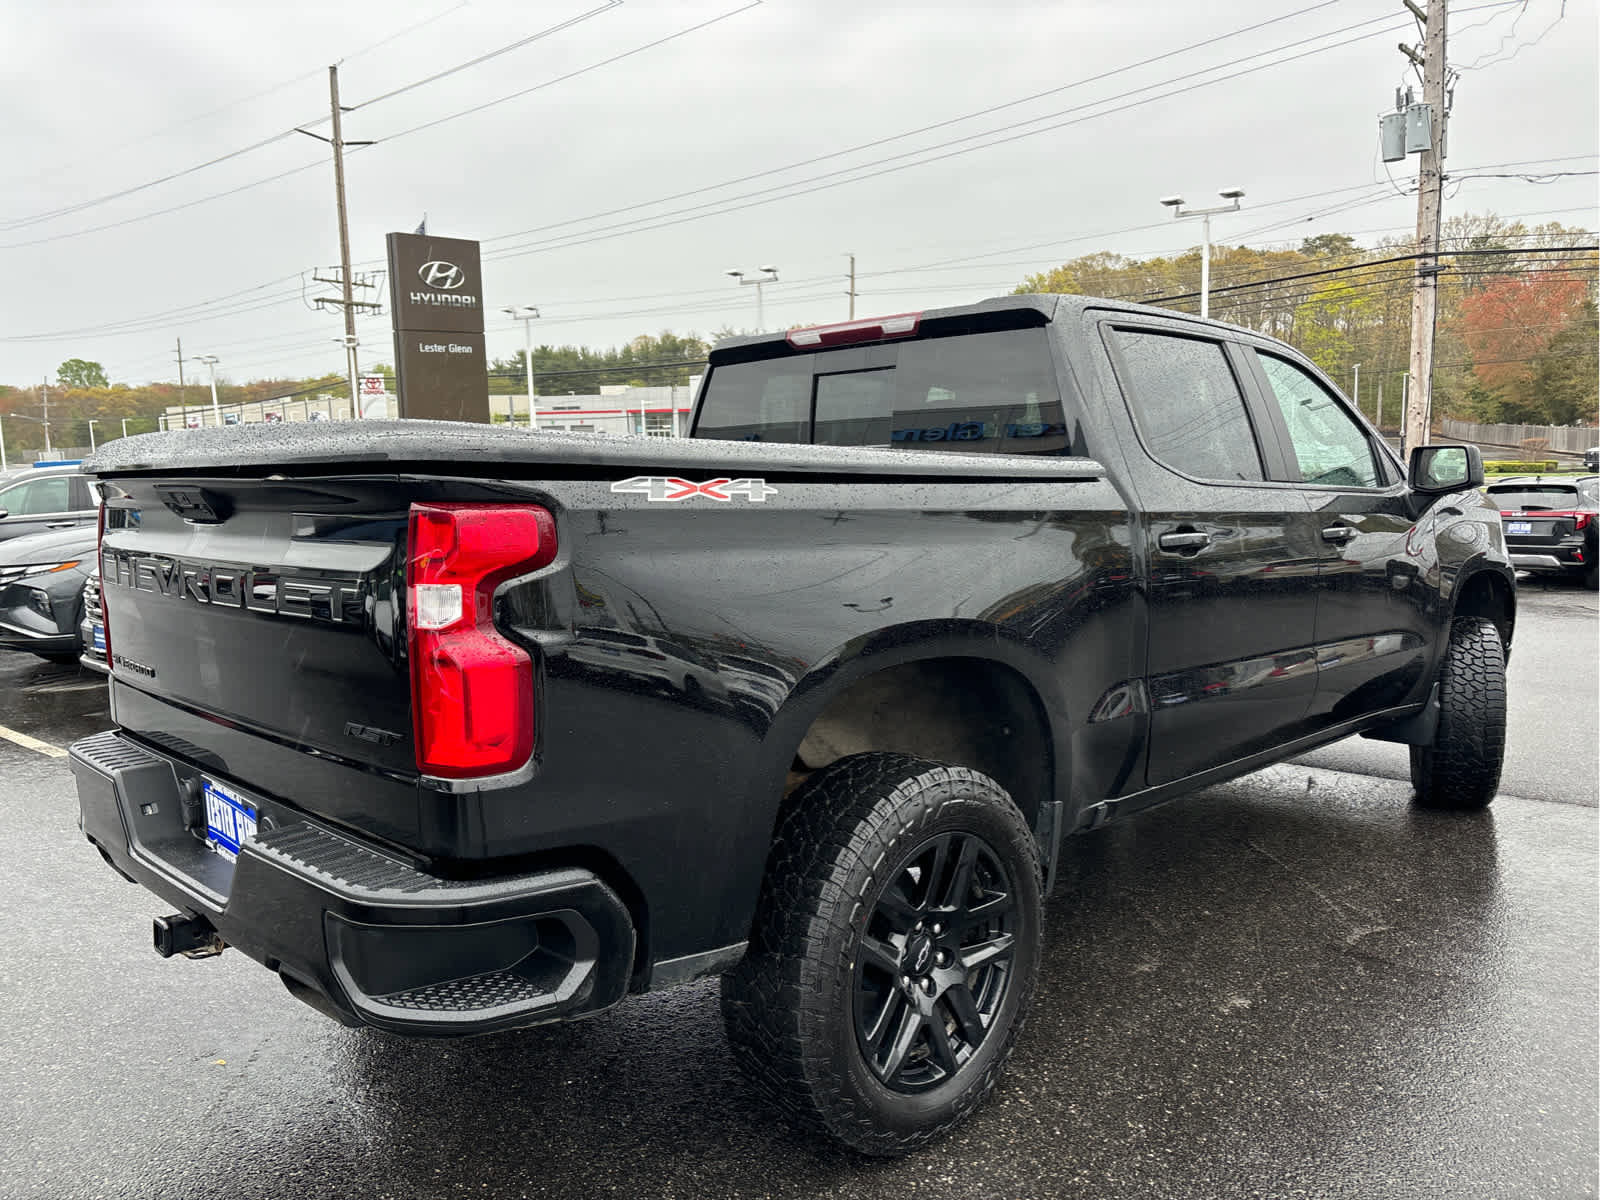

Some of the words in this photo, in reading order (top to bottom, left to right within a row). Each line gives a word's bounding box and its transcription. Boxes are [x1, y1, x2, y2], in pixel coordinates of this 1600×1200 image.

[410, 291, 476, 304] HYUNDAI
[419, 343, 446, 354] Lester
[449, 343, 473, 354] Glenn
[102, 547, 362, 622] CHEVROLET
[343, 720, 404, 746] RST
[204, 790, 237, 841] LESTER
